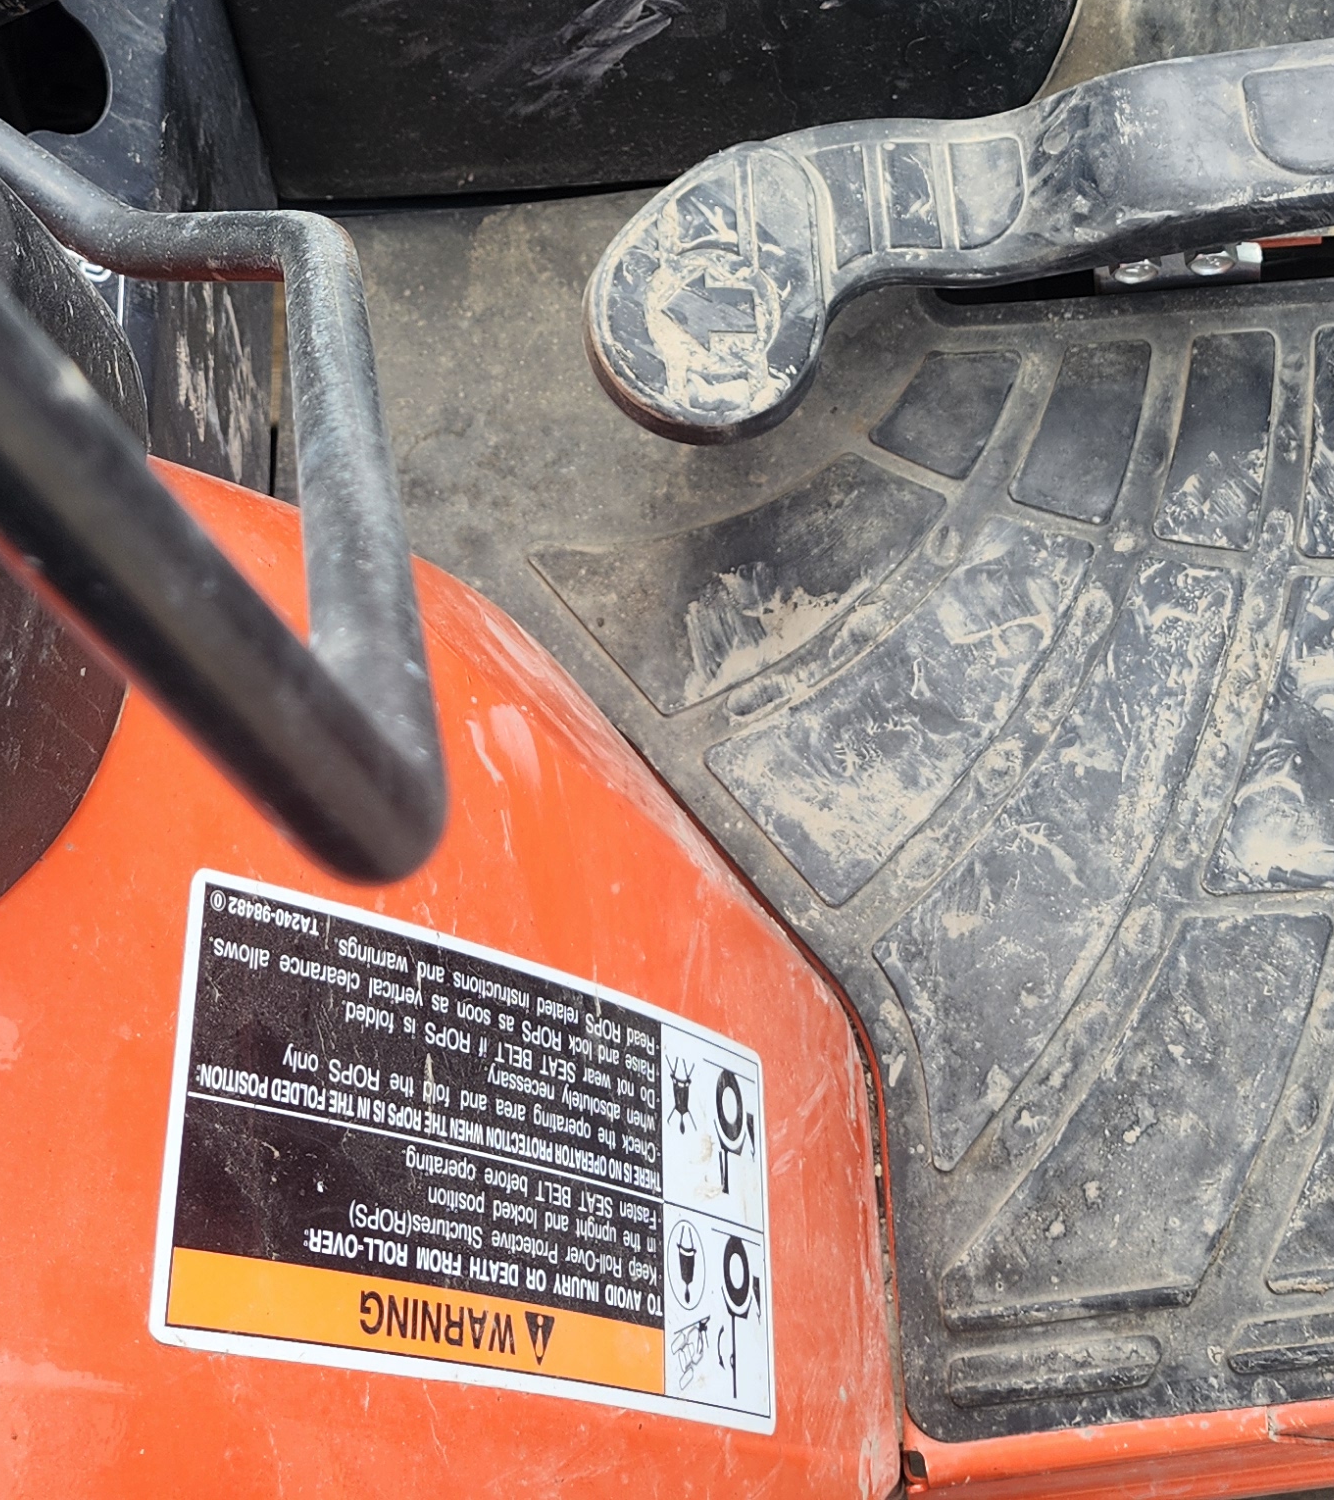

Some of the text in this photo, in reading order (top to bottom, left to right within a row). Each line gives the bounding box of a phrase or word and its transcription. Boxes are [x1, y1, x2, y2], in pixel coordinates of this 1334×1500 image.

[227, 896, 318, 936] TA240-98482
[208, 936, 270, 970] allows.
[333, 936, 408, 973] warnings.
[278, 954, 360, 992] clearance
[416, 961, 445, 983] and
[368, 977, 422, 1006] vertical
[430, 994, 449, 1013] as
[451, 971, 529, 1014] instructions
[341, 1000, 394, 1034] folded.
[456, 1001, 491, 1025] soon
[497, 1013, 514, 1032] as
[536, 997, 578, 1025] related
[402, 1016, 416, 1039] is
[424, 1022, 470, 1053] ROPS
[521, 1020, 561, 1051] ROPS
[584, 1013, 620, 1043] ROPS
[281, 1043, 319, 1073] only
[477, 1036, 487, 1058] if
[493, 1042, 532, 1070] BELT
[567, 1034, 592, 1061] lock
[596, 1044, 619, 1065] and
[328, 1059, 380, 1091] ROPS
[538, 1055, 576, 1083] SEAT
[581, 1067, 611, 1089] wear
[389, 1073, 413, 1098] the
[422, 1079, 449, 1107] fold
[483, 1063, 655, 1132] when absolutely necessary.
[616, 1077, 634, 1097] not
[459, 1090, 487, 1111] and
[494, 1098, 526, 1121] area
[195, 1063, 661, 1192] THERE IS NO OPERATOR PROTECTION WHEN THE ROPS IS IN THE FOLDED POSITION:
[532, 1103, 591, 1139] operating
[597, 1127, 616, 1150] the
[401, 1145, 476, 1181] operating.
[483, 1168, 528, 1197] before
[534, 1180, 571, 1208] BELT
[577, 1191, 613, 1218] SEAT
[427, 1186, 656, 1258] in the upright and locked position
[490, 1230, 557, 1264] Protective
[302, 1228, 662, 1316] TO AVOID INJURY OR DEATH FROM ROLL-OVER:
[564, 1246, 622, 1278] Roll-Over
[359, 1290, 515, 1355] WARNING
